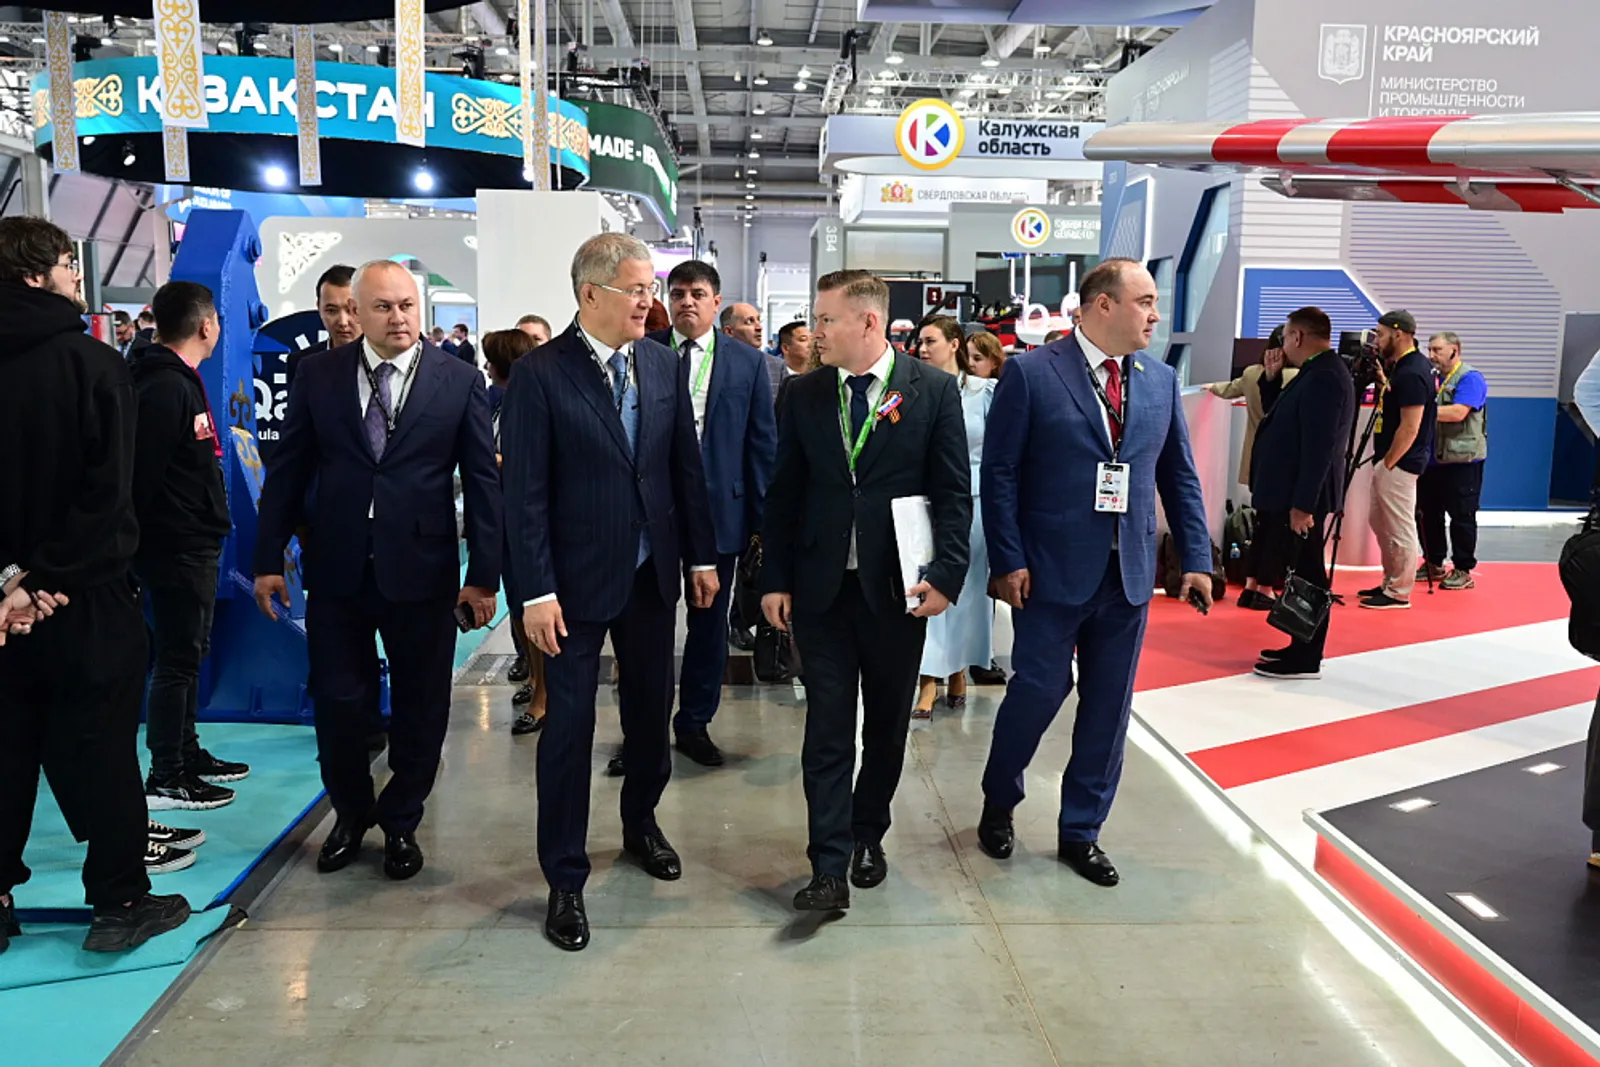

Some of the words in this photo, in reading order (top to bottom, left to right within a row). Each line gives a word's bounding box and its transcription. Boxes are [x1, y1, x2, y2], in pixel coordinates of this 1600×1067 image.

[1384, 25, 1540, 46] КРАСНОЯРСКИЙ
[1382, 43, 1434, 63] КРАЙ
[1380, 76, 1498, 92] МИНИСТЕРСТВО
[137, 74, 435, 128] ҚЗАҚСТА
[1379, 91, 1525, 108] ПРОМЫШЛЕННОСТИ
[978, 120, 1079, 141] Калужская
[978, 137, 1051, 156] область
[917, 189, 988, 201] СВЕРДЛОВСКАЯ
